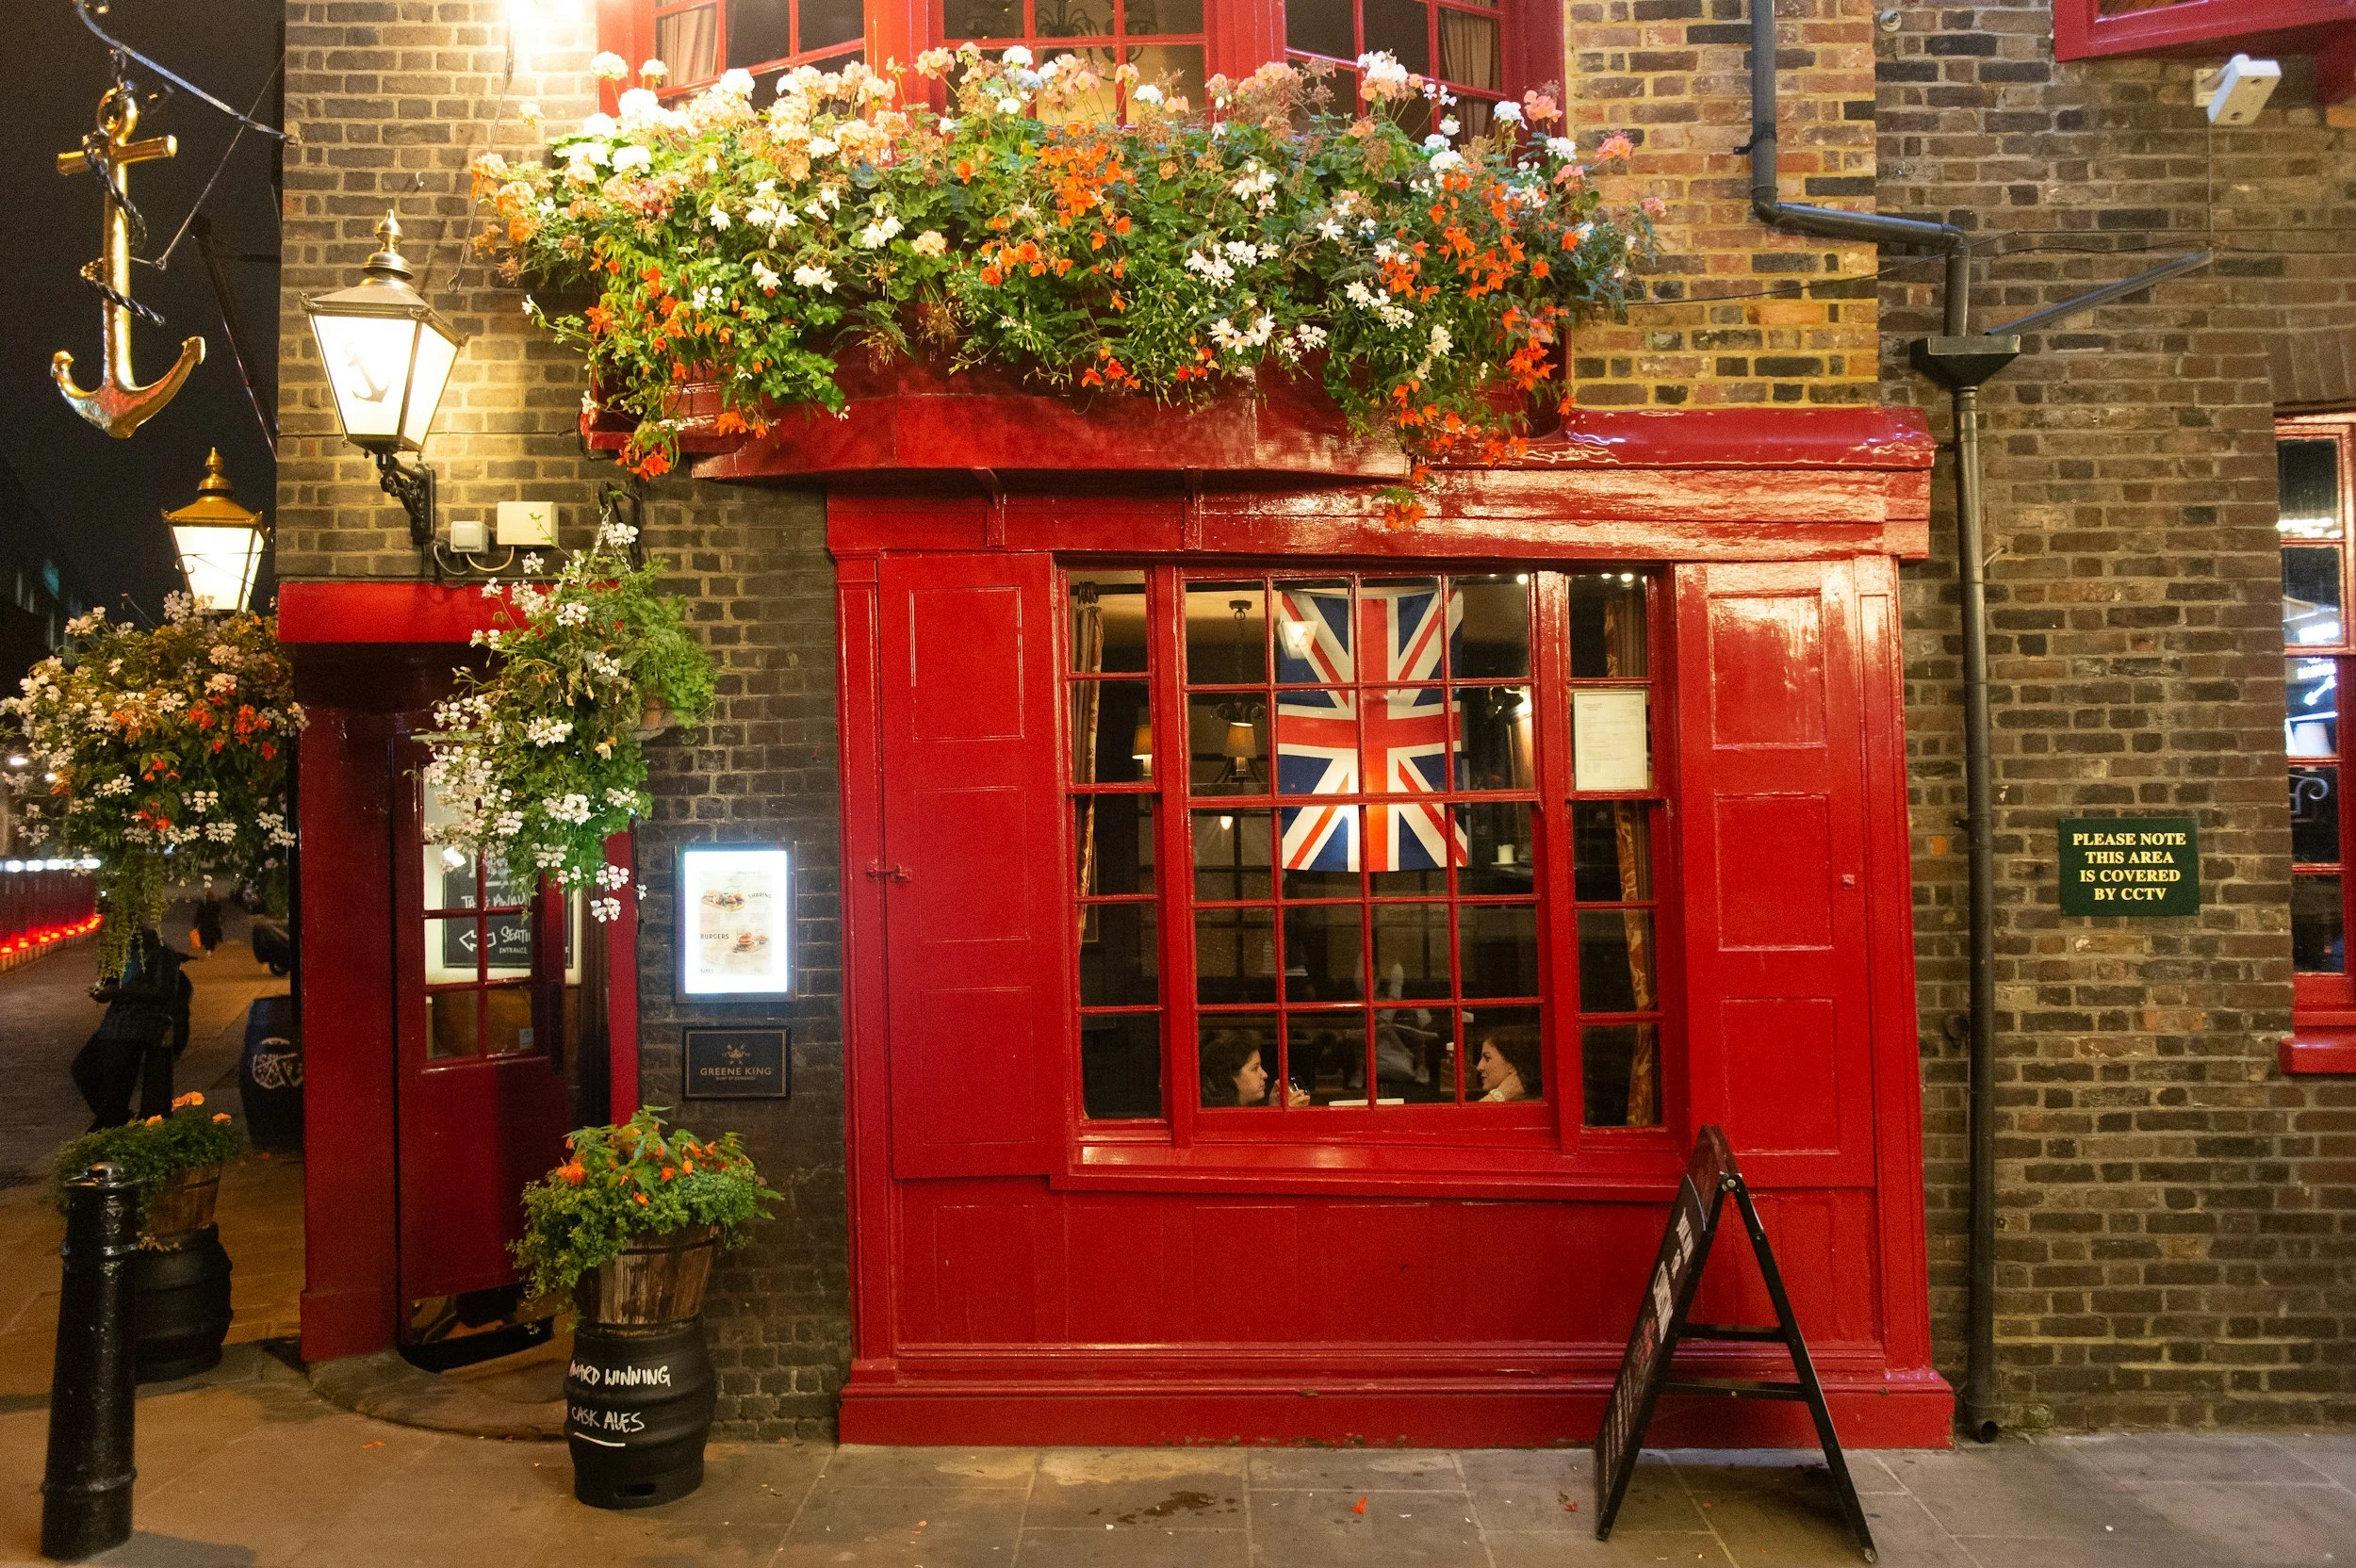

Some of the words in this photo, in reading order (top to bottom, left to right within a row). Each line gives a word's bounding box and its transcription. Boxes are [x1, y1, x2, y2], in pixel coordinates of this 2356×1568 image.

[2072, 833, 2136, 846] PLEASE
[2139, 833, 2186, 846] NOTE
[2085, 851, 2125, 864] THIS
[2128, 851, 2175, 864] AREA
[2079, 869, 2096, 883] IS
[2099, 869, 2182, 883] COVERED
[2094, 888, 2118, 901] BY
[2120, 888, 2168, 901] CCTV
[460, 894, 490, 909] TAE
[499, 946, 529, 955] ENTRANCE
[699, 1067, 742, 1076] GREENE
[744, 1067, 772, 1076] KING
[604, 1364, 672, 1387] WINNING
[571, 1405, 601, 1428] CASK
[603, 1410, 646, 1433] ALES
